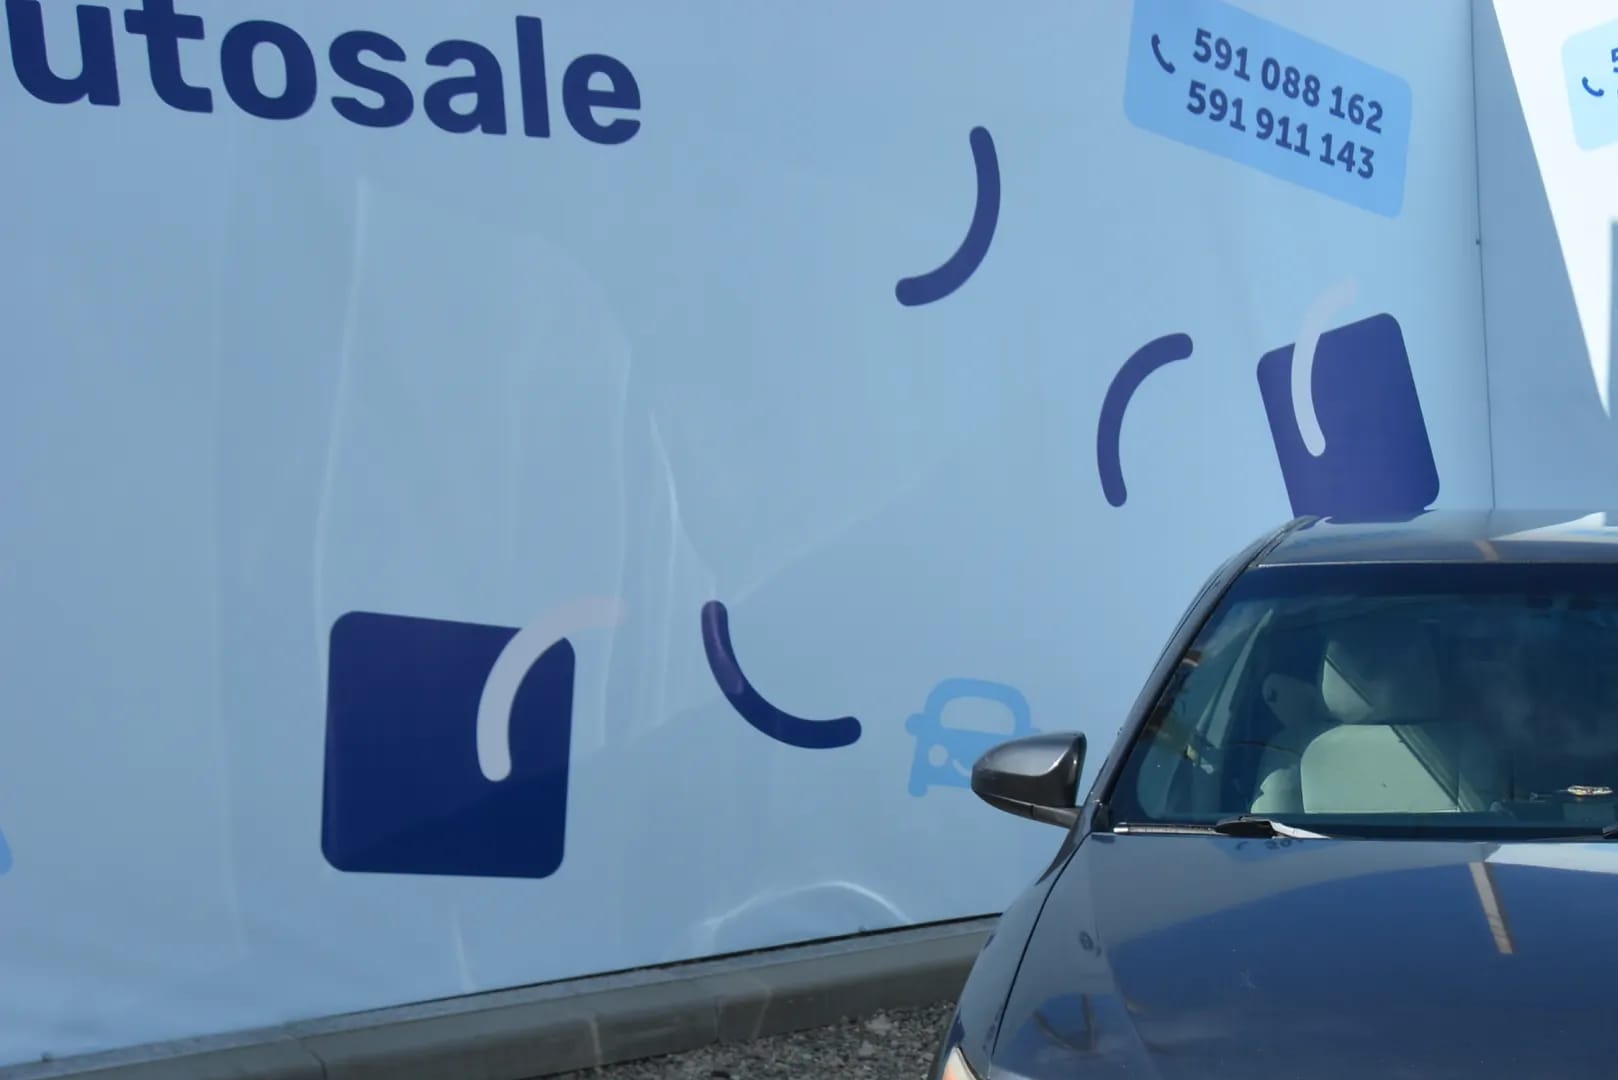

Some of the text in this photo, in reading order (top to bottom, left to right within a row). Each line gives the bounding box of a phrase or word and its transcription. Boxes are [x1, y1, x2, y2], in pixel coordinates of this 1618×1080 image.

[1187, 79, 1375, 180] 591 911 143
[1193, 28, 1384, 135] 591 088 162
